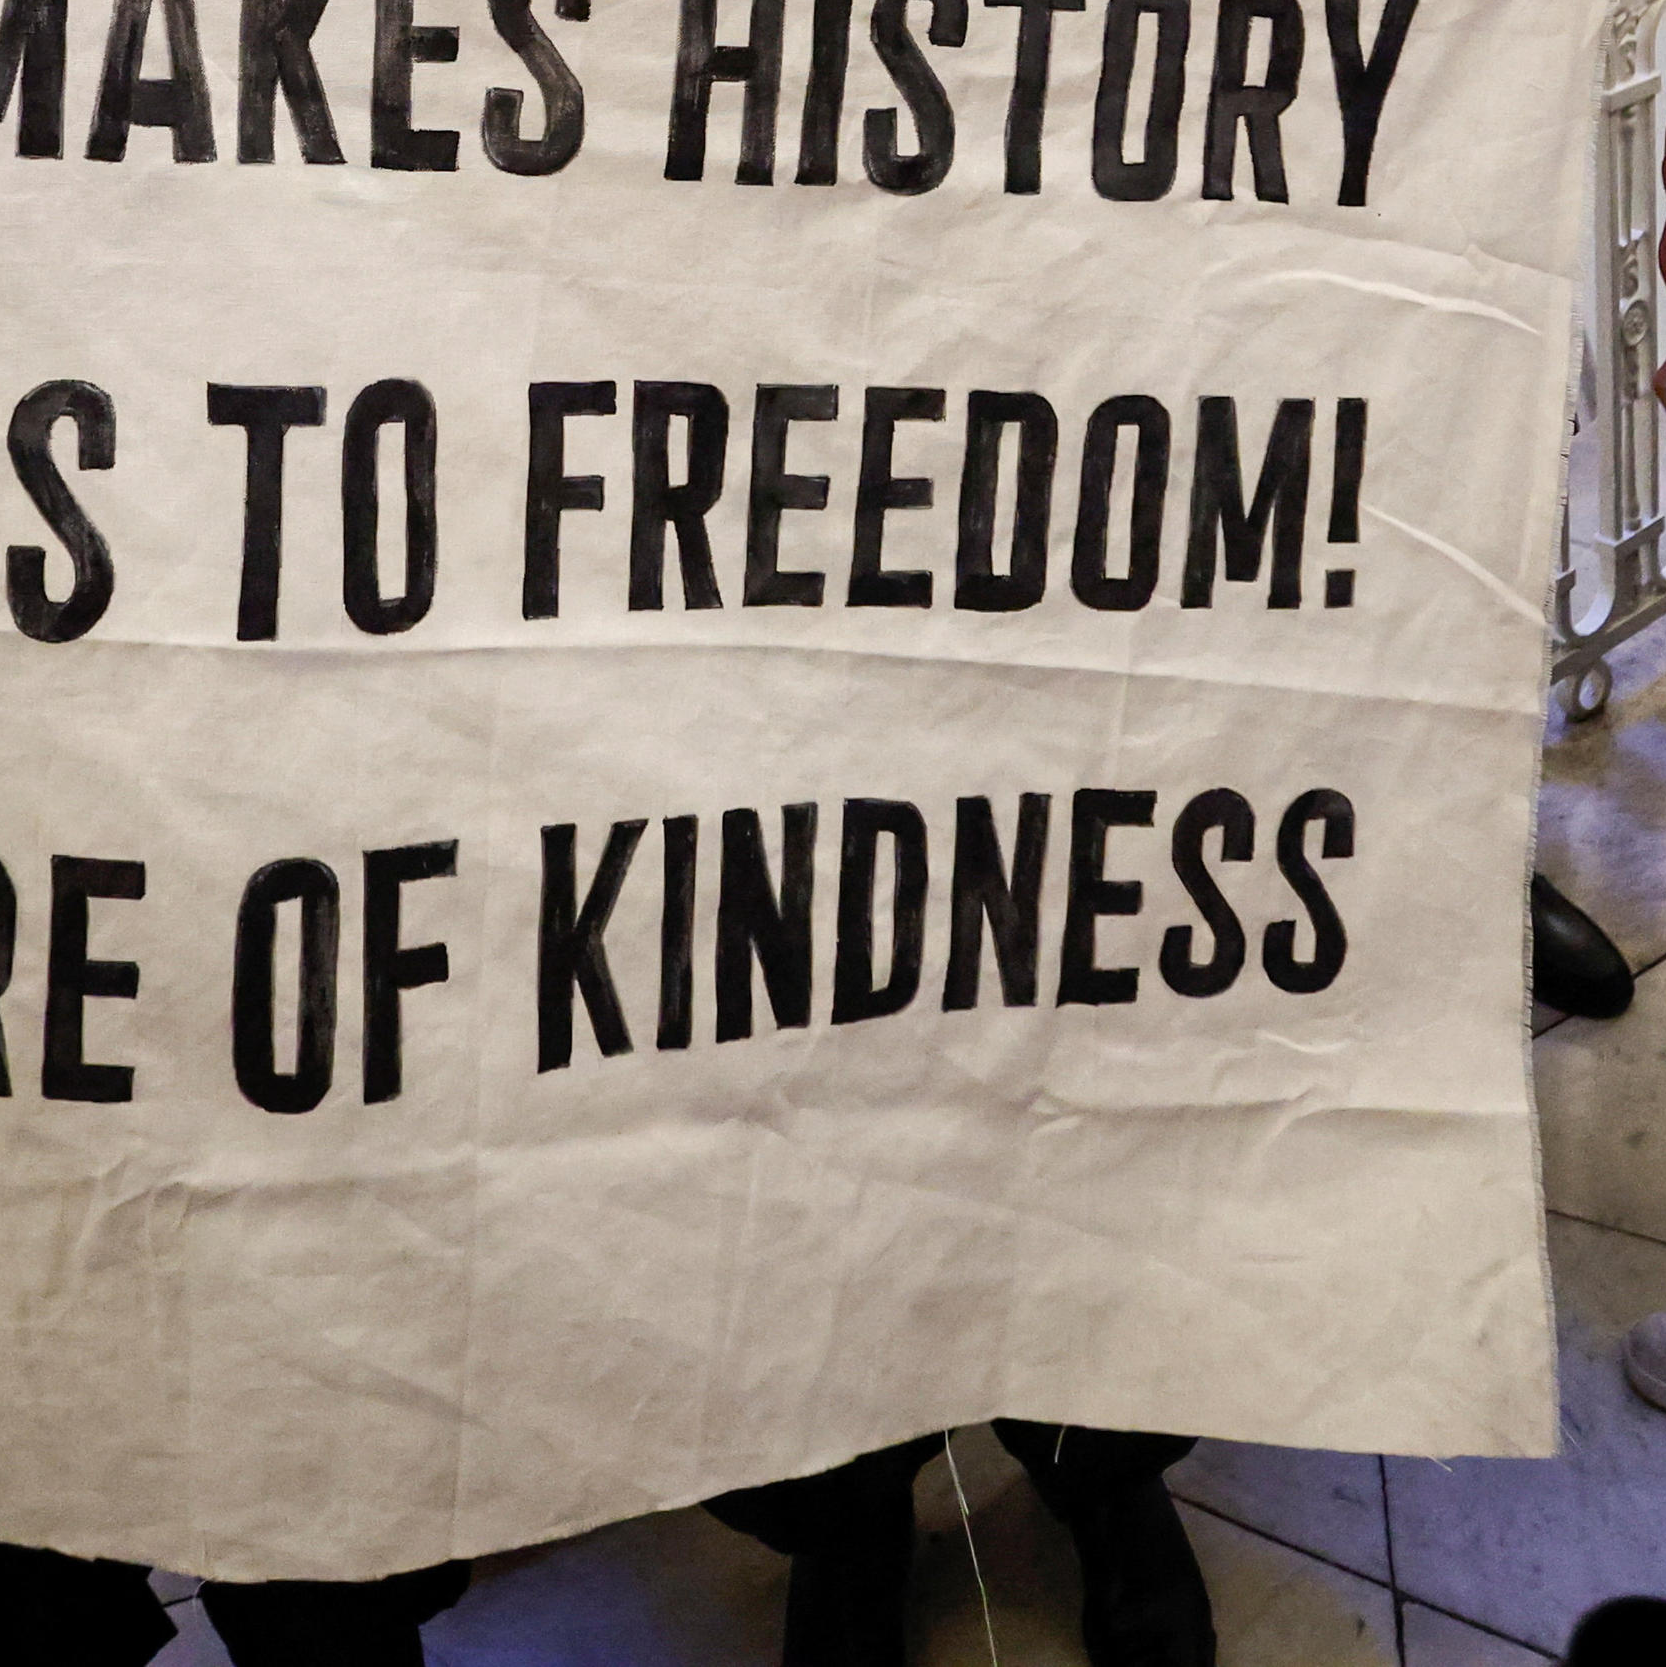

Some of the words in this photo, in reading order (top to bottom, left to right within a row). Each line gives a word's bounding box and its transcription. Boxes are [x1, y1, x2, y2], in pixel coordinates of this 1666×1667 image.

[207, 379, 437, 641] TO
[522, 380, 1367, 620] FREEDOM!
[231, 839, 459, 1114] OF
[537, 788, 1355, 1074] KINDNESS
